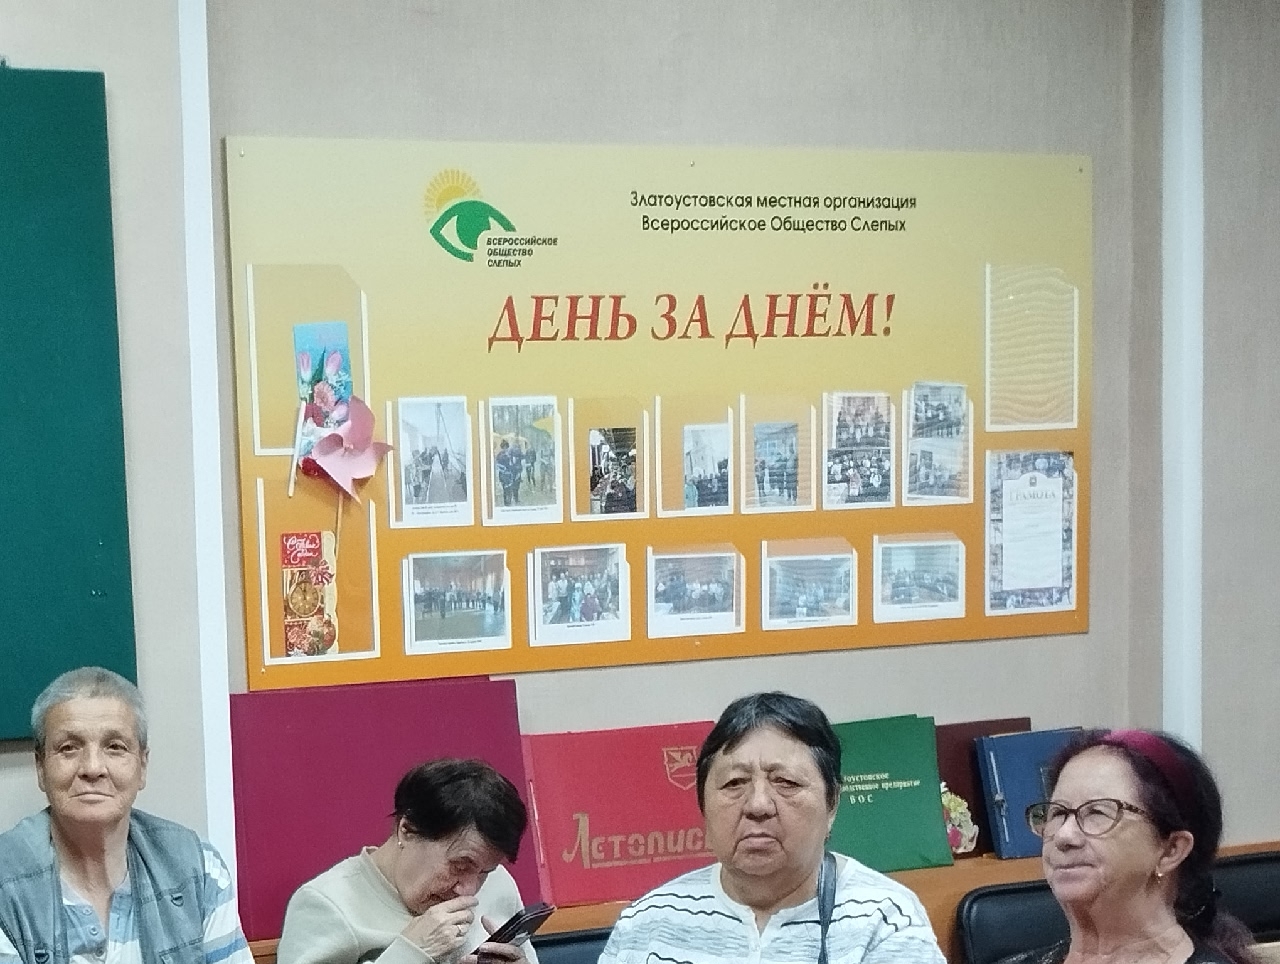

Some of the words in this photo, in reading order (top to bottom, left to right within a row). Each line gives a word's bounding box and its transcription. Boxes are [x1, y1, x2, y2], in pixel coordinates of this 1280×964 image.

[630, 190, 752, 210] Златоустовская
[756, 195, 819, 208] местная
[823, 196, 917, 211] организация
[642, 214, 766, 234] Всероссийское
[770, 215, 847, 233] Общество
[850, 216, 906, 231] Слепых
[486, 236, 558, 246] ВСЕРОССИЙСКОЕ
[487, 248, 534, 257] ОБЩЕСТВО
[487, 259, 522, 267] СЛЕПЫХ
[487, 294, 637, 353] ДЕНЬ
[650, 293, 715, 341] ЗА
[724, 282, 896, 349] ДНЁМ!
[562, 812, 713, 869] Летопис
